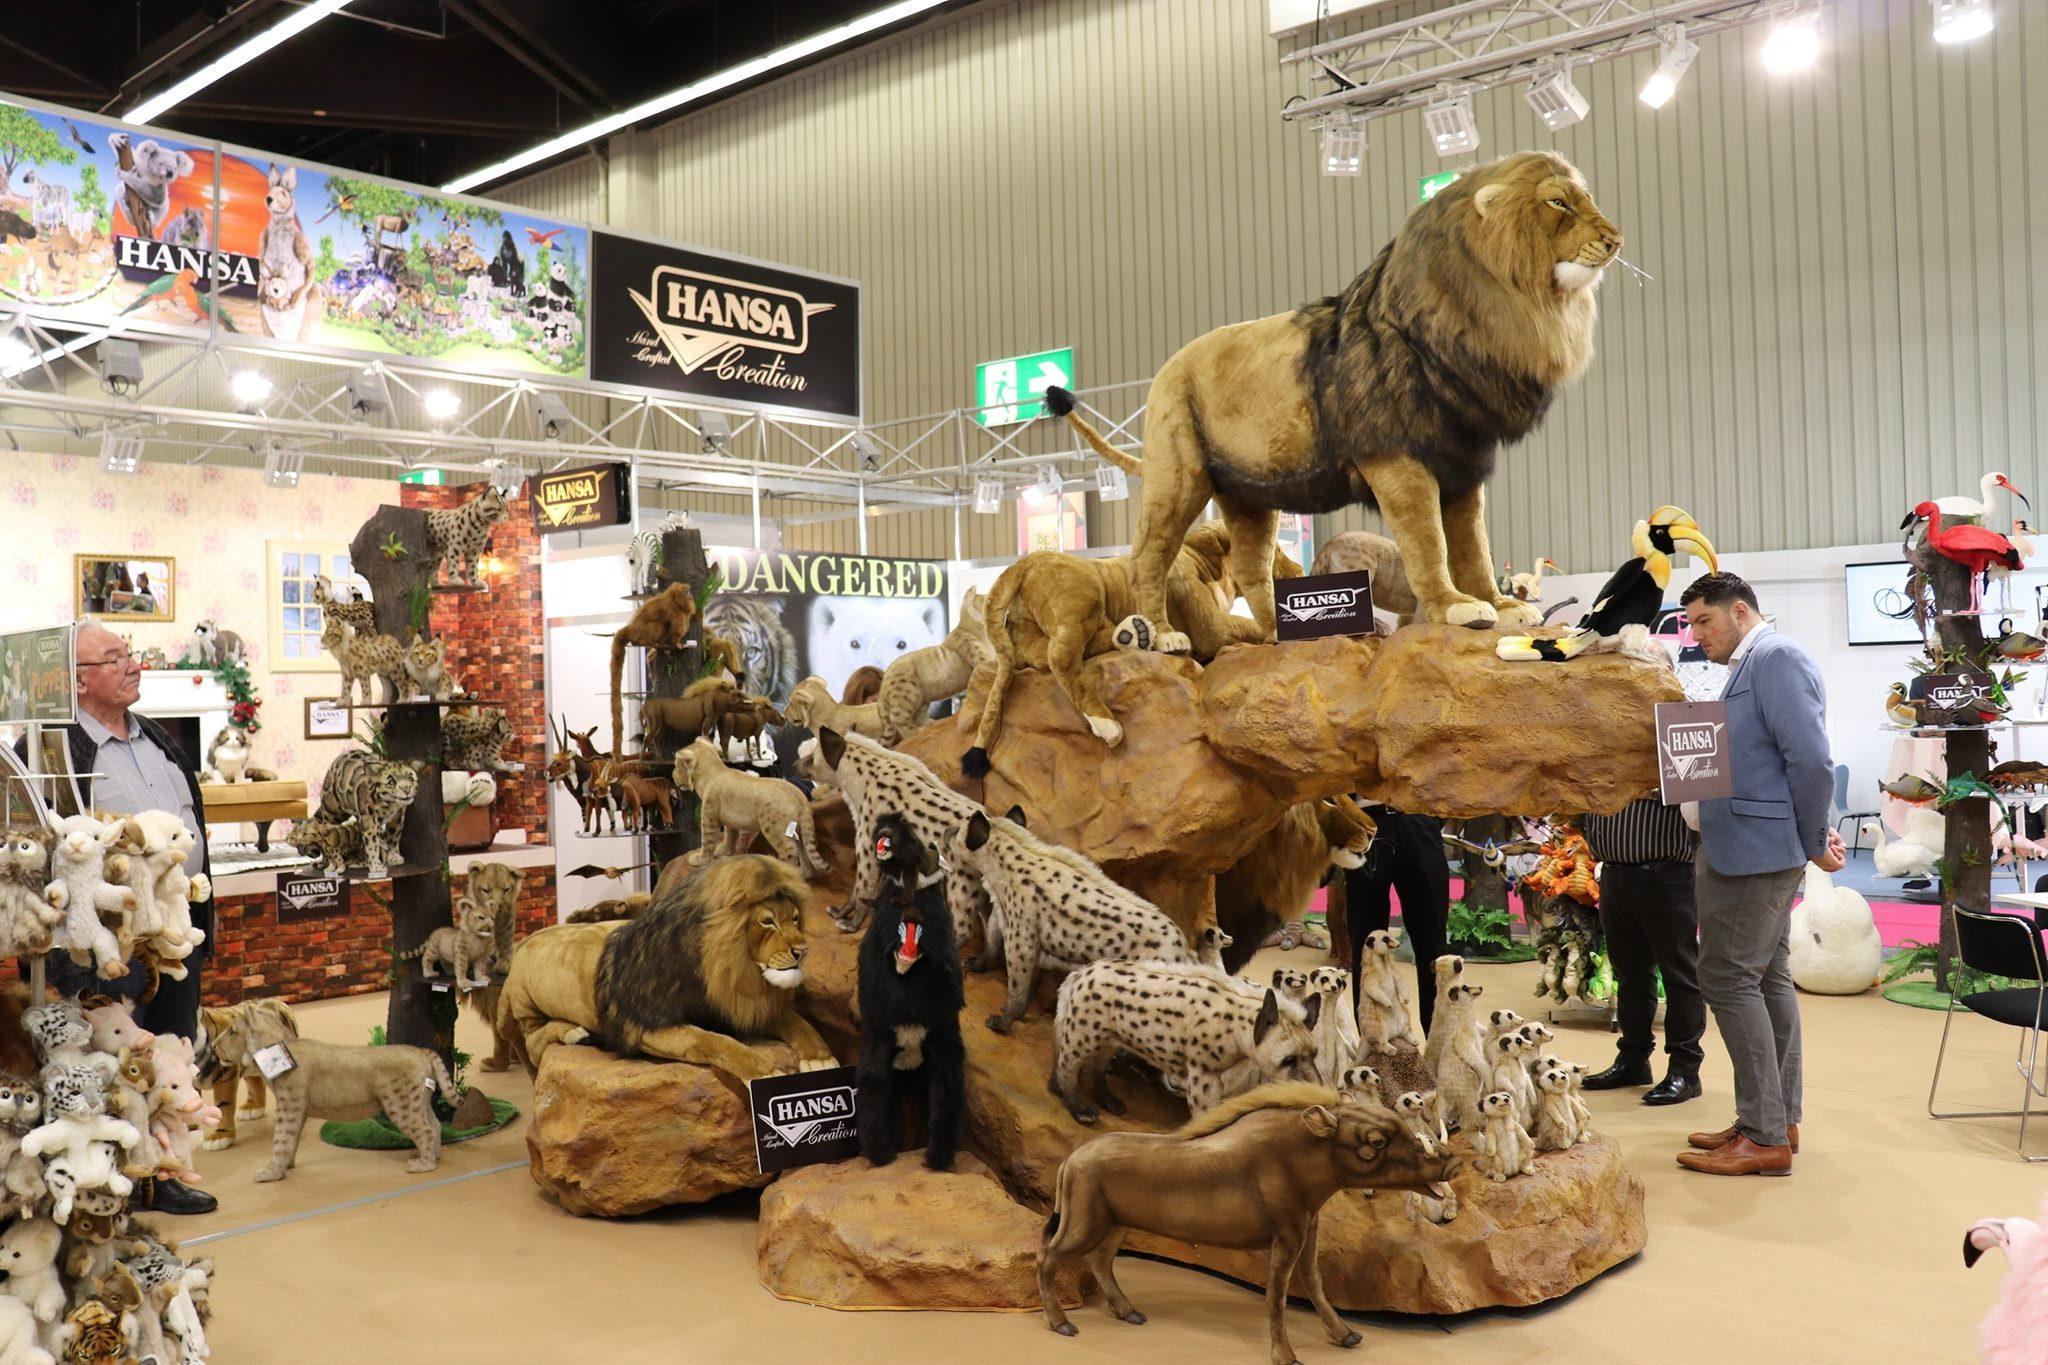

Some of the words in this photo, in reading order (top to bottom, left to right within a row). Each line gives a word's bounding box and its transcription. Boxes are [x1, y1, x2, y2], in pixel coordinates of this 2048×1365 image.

[119, 236, 258, 285] HANSA
[666, 281, 797, 341] HANSA
[626, 330, 661, 348] Hand
[632, 346, 674, 368] Crafted
[702, 346, 808, 393] Creation
[545, 478, 595, 504] HANSA
[562, 503, 601, 526] Creation
[704, 550, 944, 599] DANGERED
[1293, 592, 1351, 608] HANSA
[1310, 606, 1357, 622] Creation
[1937, 688, 1978, 699] HANA
[1671, 729, 1714, 752] HANSA
[1686, 757, 1719, 780] Creation
[291, 881, 335, 897] HANSA
[776, 1093, 848, 1121] HANSA
[800, 1120, 858, 1145] Creation
